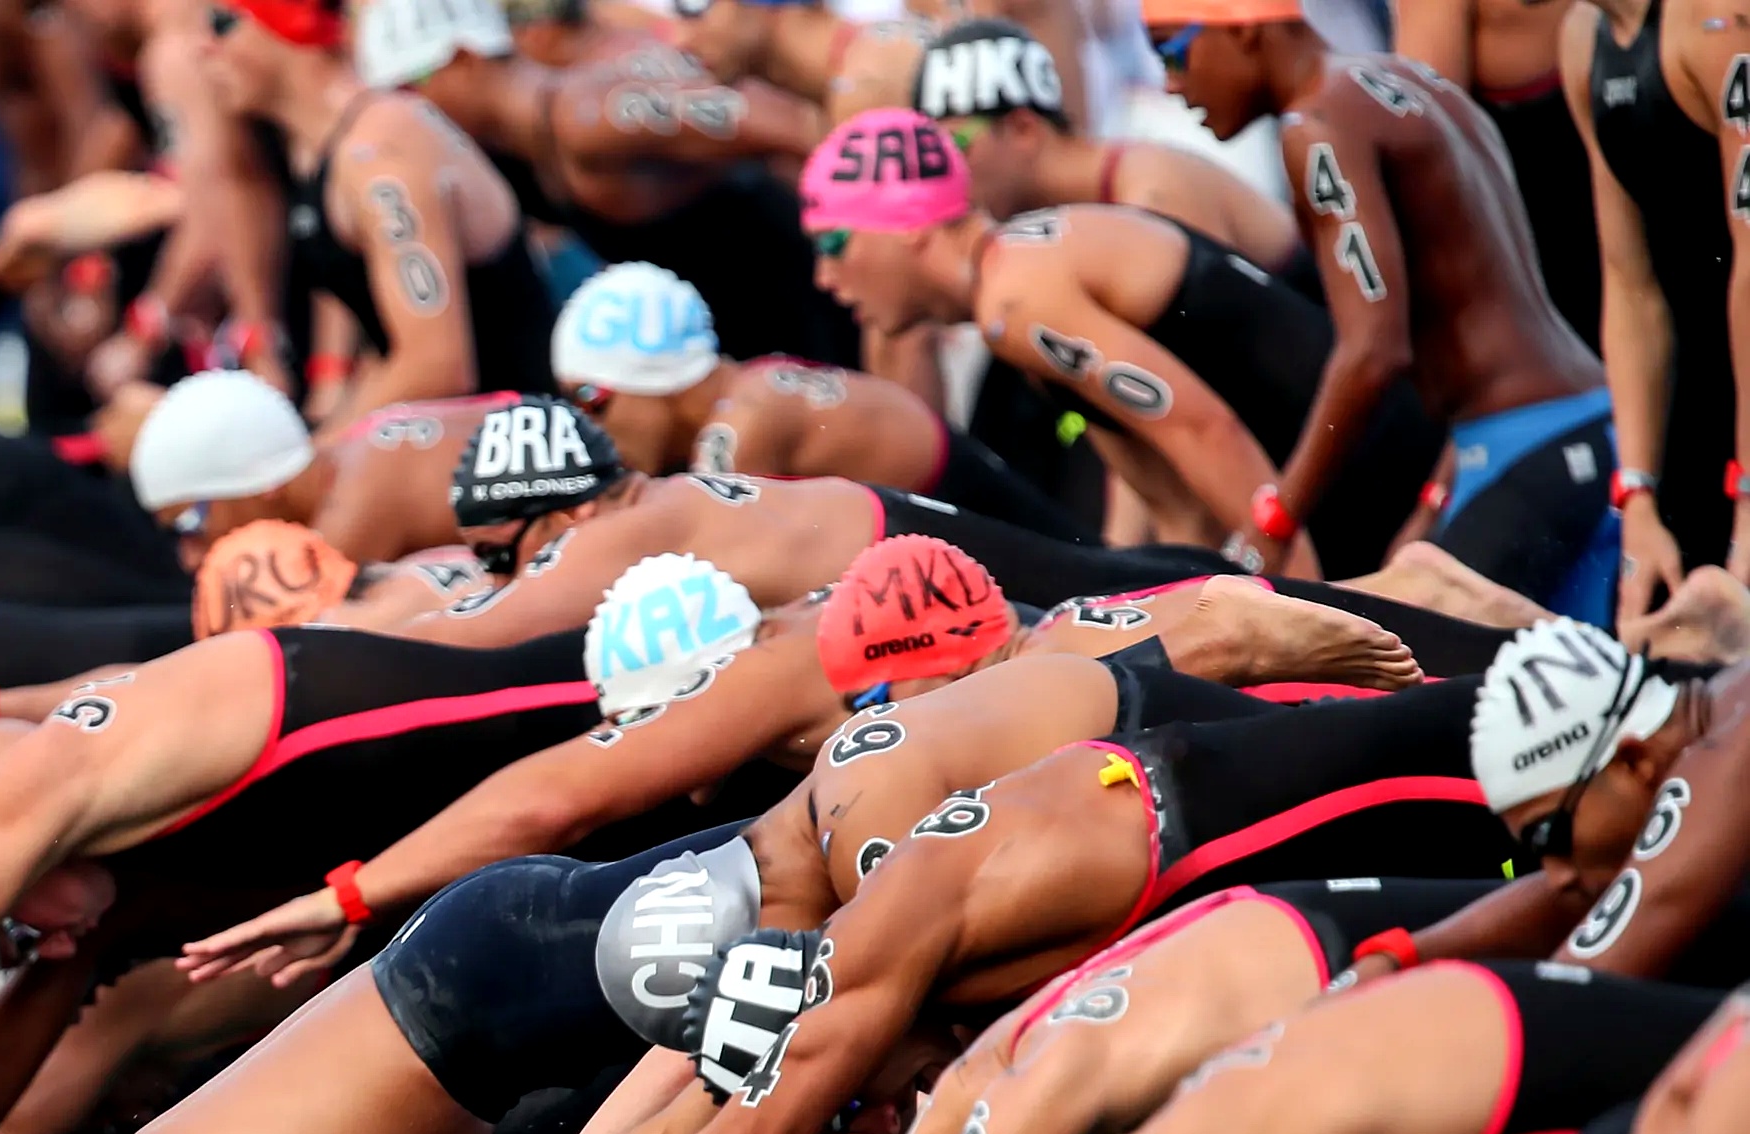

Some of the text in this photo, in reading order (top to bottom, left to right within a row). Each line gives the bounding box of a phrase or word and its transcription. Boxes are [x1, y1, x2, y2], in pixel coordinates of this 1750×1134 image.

[831, 127, 950, 183] SAB
[1306, 142, 1387, 302] 41
[1027, 321, 1175, 421] 40
[474, 405, 592, 478] BRA
[601, 574, 742, 679] KAZ
[853, 548, 991, 637] MKD
[864, 633, 936, 661] arena
[1512, 721, 1590, 772] arena
[630, 868, 715, 1009] CHN
[701, 943, 804, 1096] ITA
